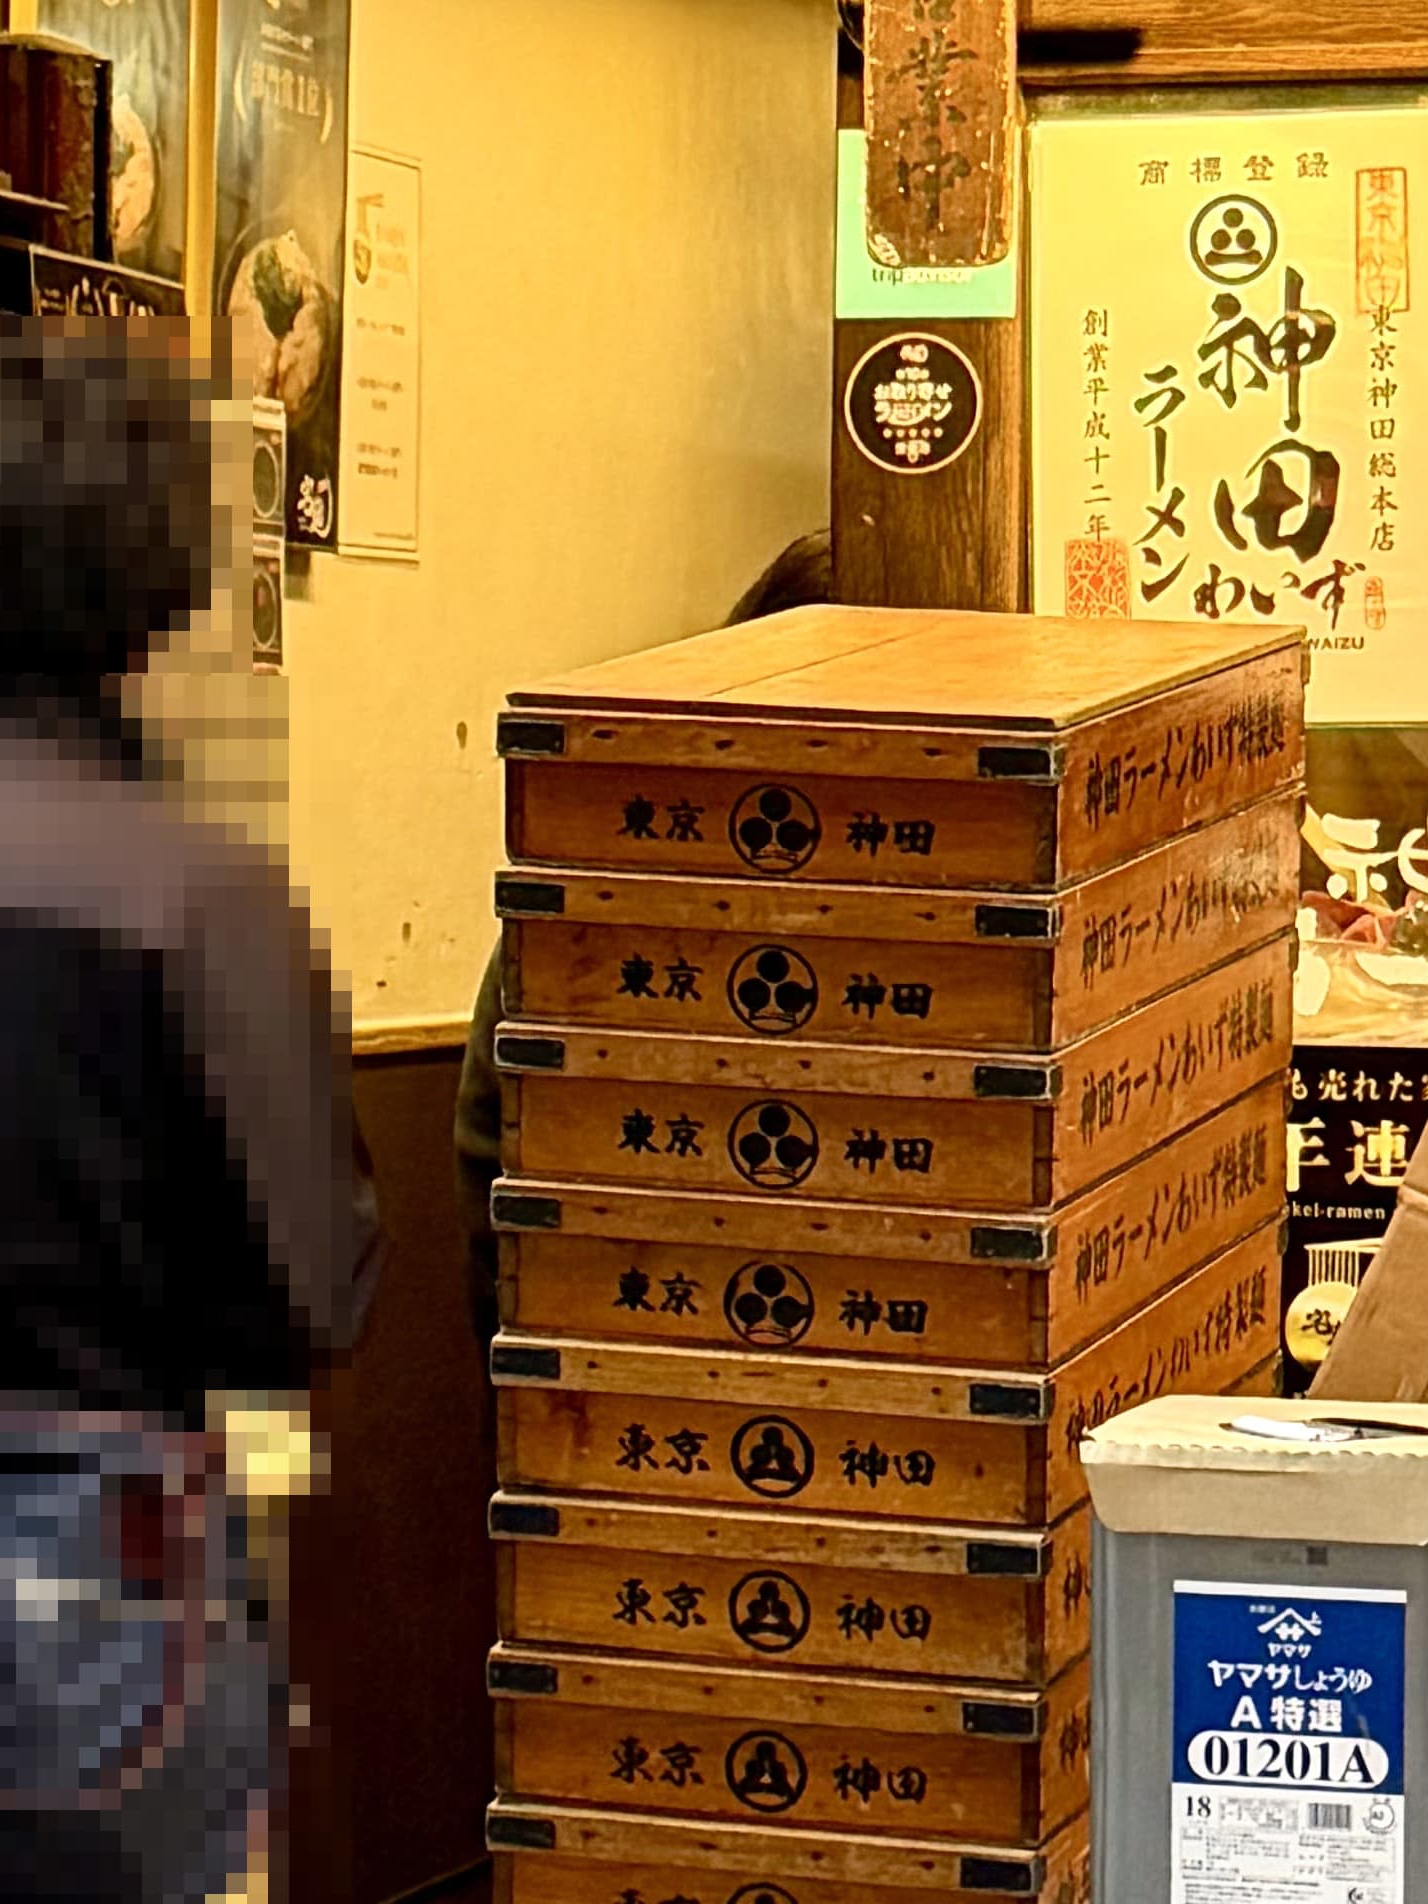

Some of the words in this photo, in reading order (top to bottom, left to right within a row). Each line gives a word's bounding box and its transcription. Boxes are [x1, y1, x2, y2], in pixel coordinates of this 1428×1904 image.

[1136, 152, 1330, 188] 商標登録
[1082, 308, 1113, 539] 創業平成十二年
[1196, 264, 1342, 564] 神田
[1366, 304, 1400, 553] 東京神田総本店
[1132, 363, 1192, 605] ラーメン
[1193, 558, 1368, 630] わいず
[619, 792, 705, 843] 東京
[845, 809, 937, 858] 神田
[616, 954, 704, 1004] 東京
[841, 971, 935, 1021] 神田
[618, 1107, 704, 1159] 東京
[843, 1126, 935, 1176] 神田
[612, 1265, 701, 1315] 東京
[838, 1287, 929, 1336] 神田
[614, 1422, 711, 1476] 東京
[838, 1439, 937, 1489] 神田
[611, 1577, 708, 1631] 東京
[835, 1595, 933, 1643] 神田
[1207, 1660, 1373, 1695] ヤマサしょうゆ
[1268, 1642, 1312, 1659] ヤマサ
[1230, 1696, 1261, 1730] A
[1270, 1698, 1343, 1733] 特選
[608, 1736, 704, 1788] 東京
[831, 1754, 929, 1807] 神田
[1203, 1734, 1373, 1785] 01201A
[1184, 1795, 1212, 1819] 18
